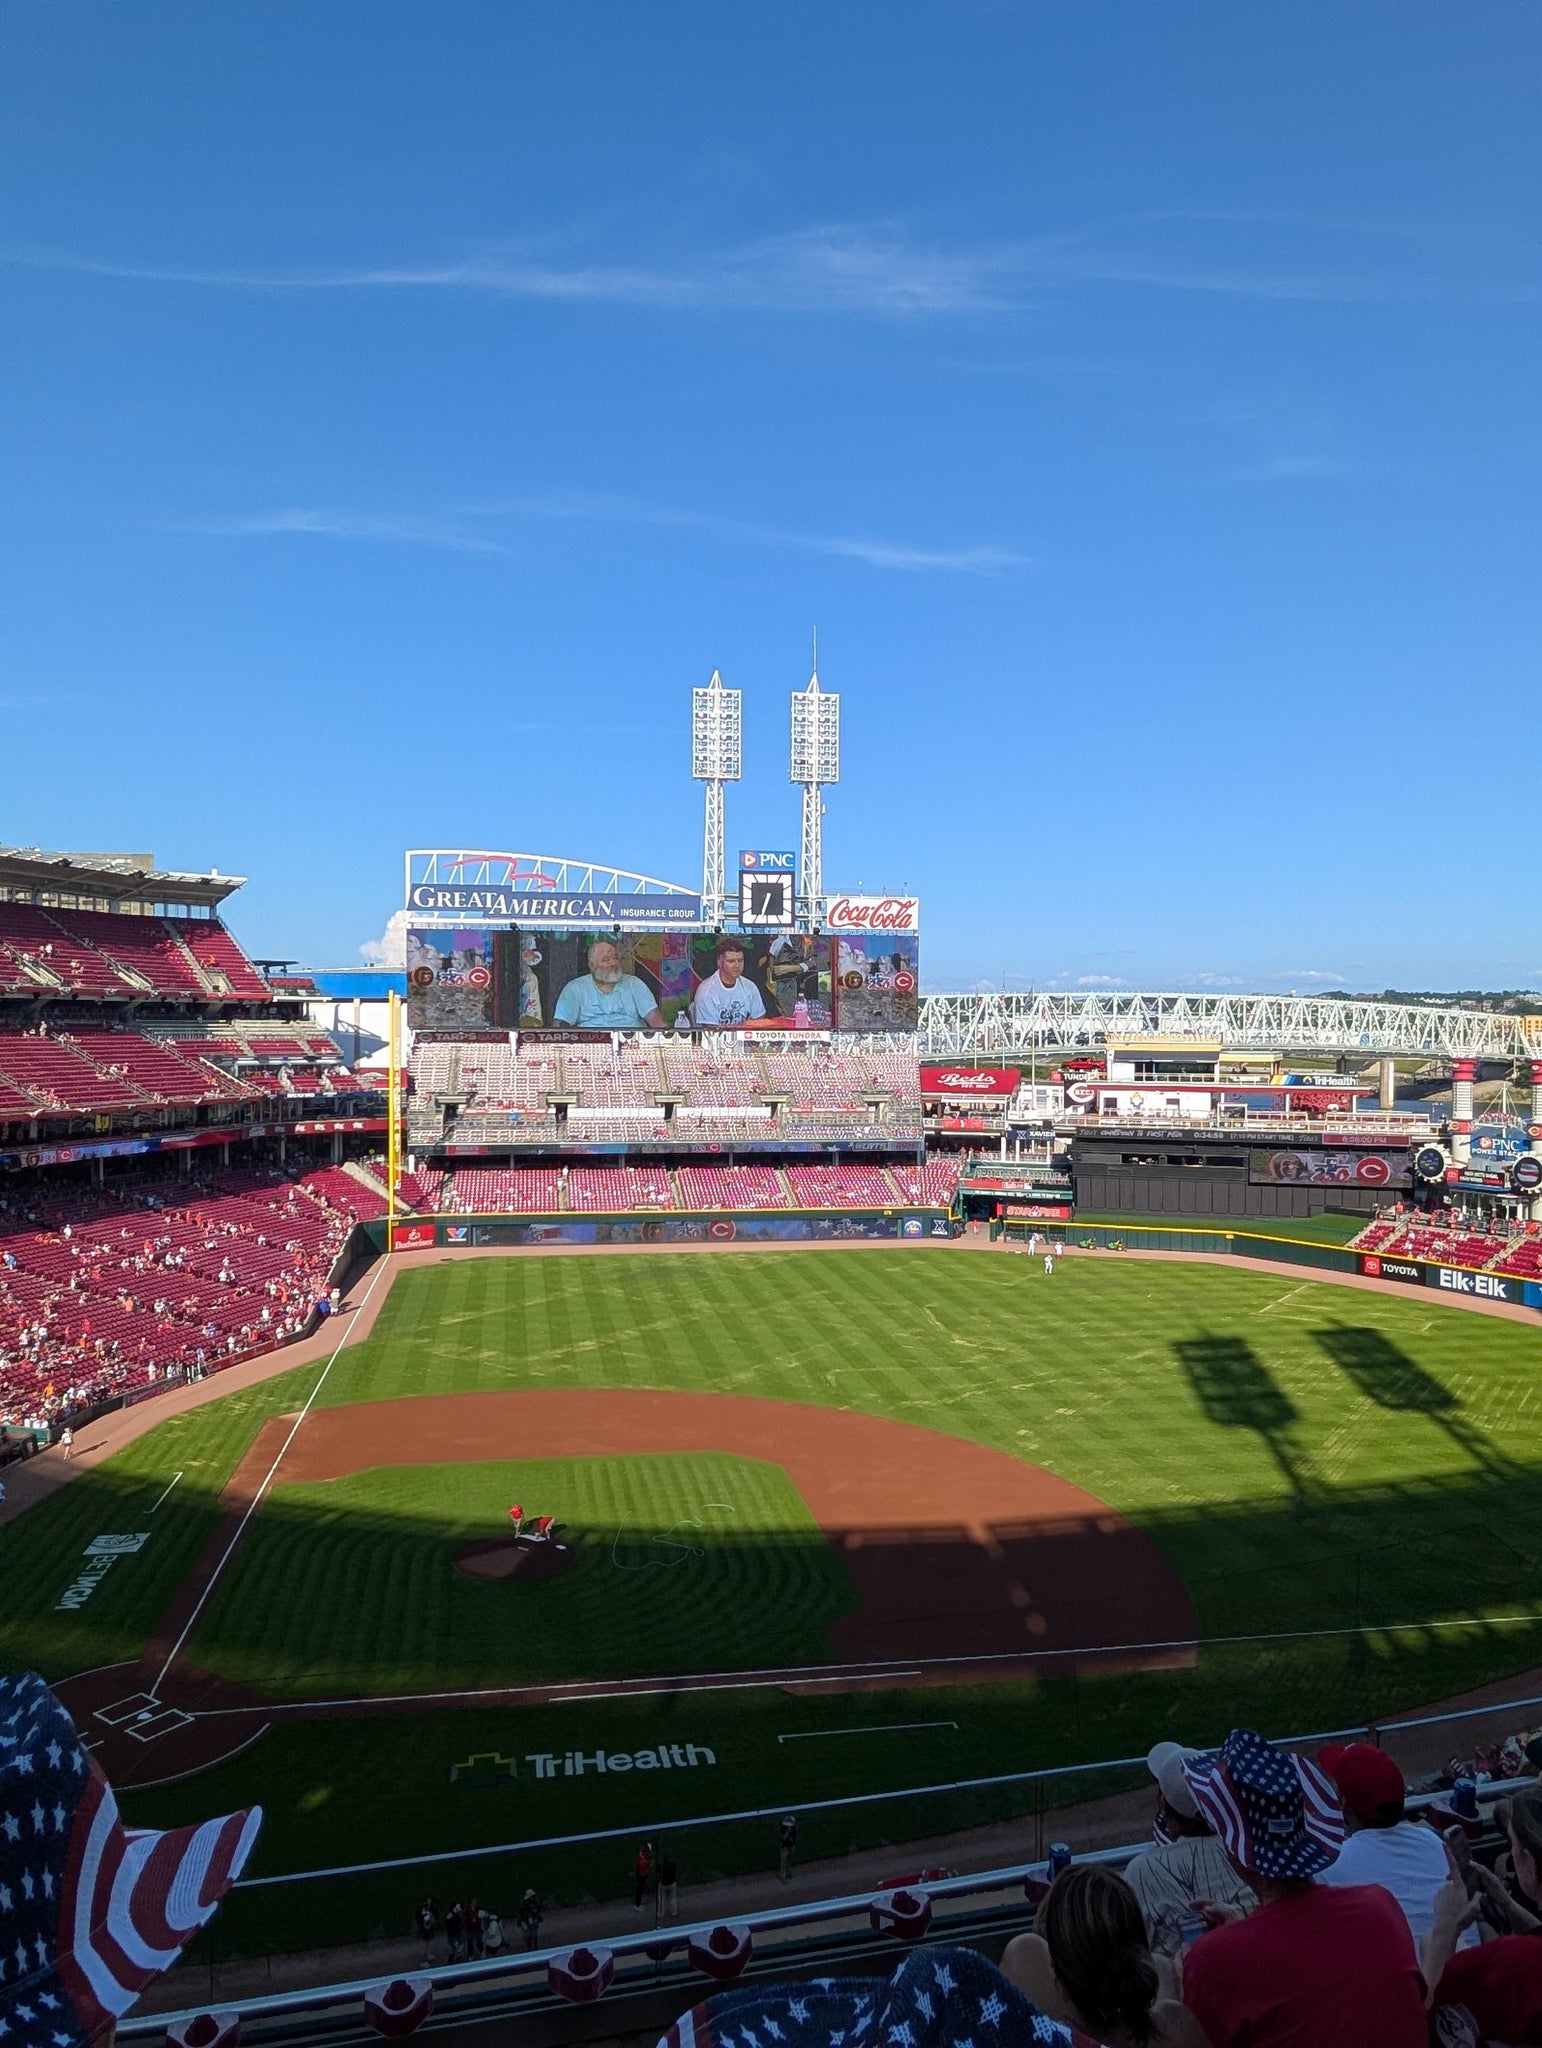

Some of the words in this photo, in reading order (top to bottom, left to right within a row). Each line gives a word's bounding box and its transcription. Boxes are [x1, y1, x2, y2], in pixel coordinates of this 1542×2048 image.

[759, 853, 794, 867] PNC
[413, 886, 497, 908] GREAT
[620, 909, 666, 918] INSURANCE
[668, 909, 696, 919] GROUP
[828, 898, 917, 929] Coca-Cola
[435, 1032, 477, 1041] TARPS
[538, 1032, 579, 1041] TARPS
[788, 1032, 821, 1040] TUNDRA
[937, 1073, 997, 1087] Reds
[1312, 1075, 1356, 1086] TriHealth
[1029, 1130, 1056, 1138] XAVIER
[1472, 1147, 1497, 1155] POWER
[1492, 1139, 1520, 1151] PNC
[394, 1238, 434, 1249] Budweiser
[1382, 1263, 1419, 1277] TOYOTA
[54, 1554, 119, 1611] BETMGM
[525, 1743, 717, 1779] TriHealth
